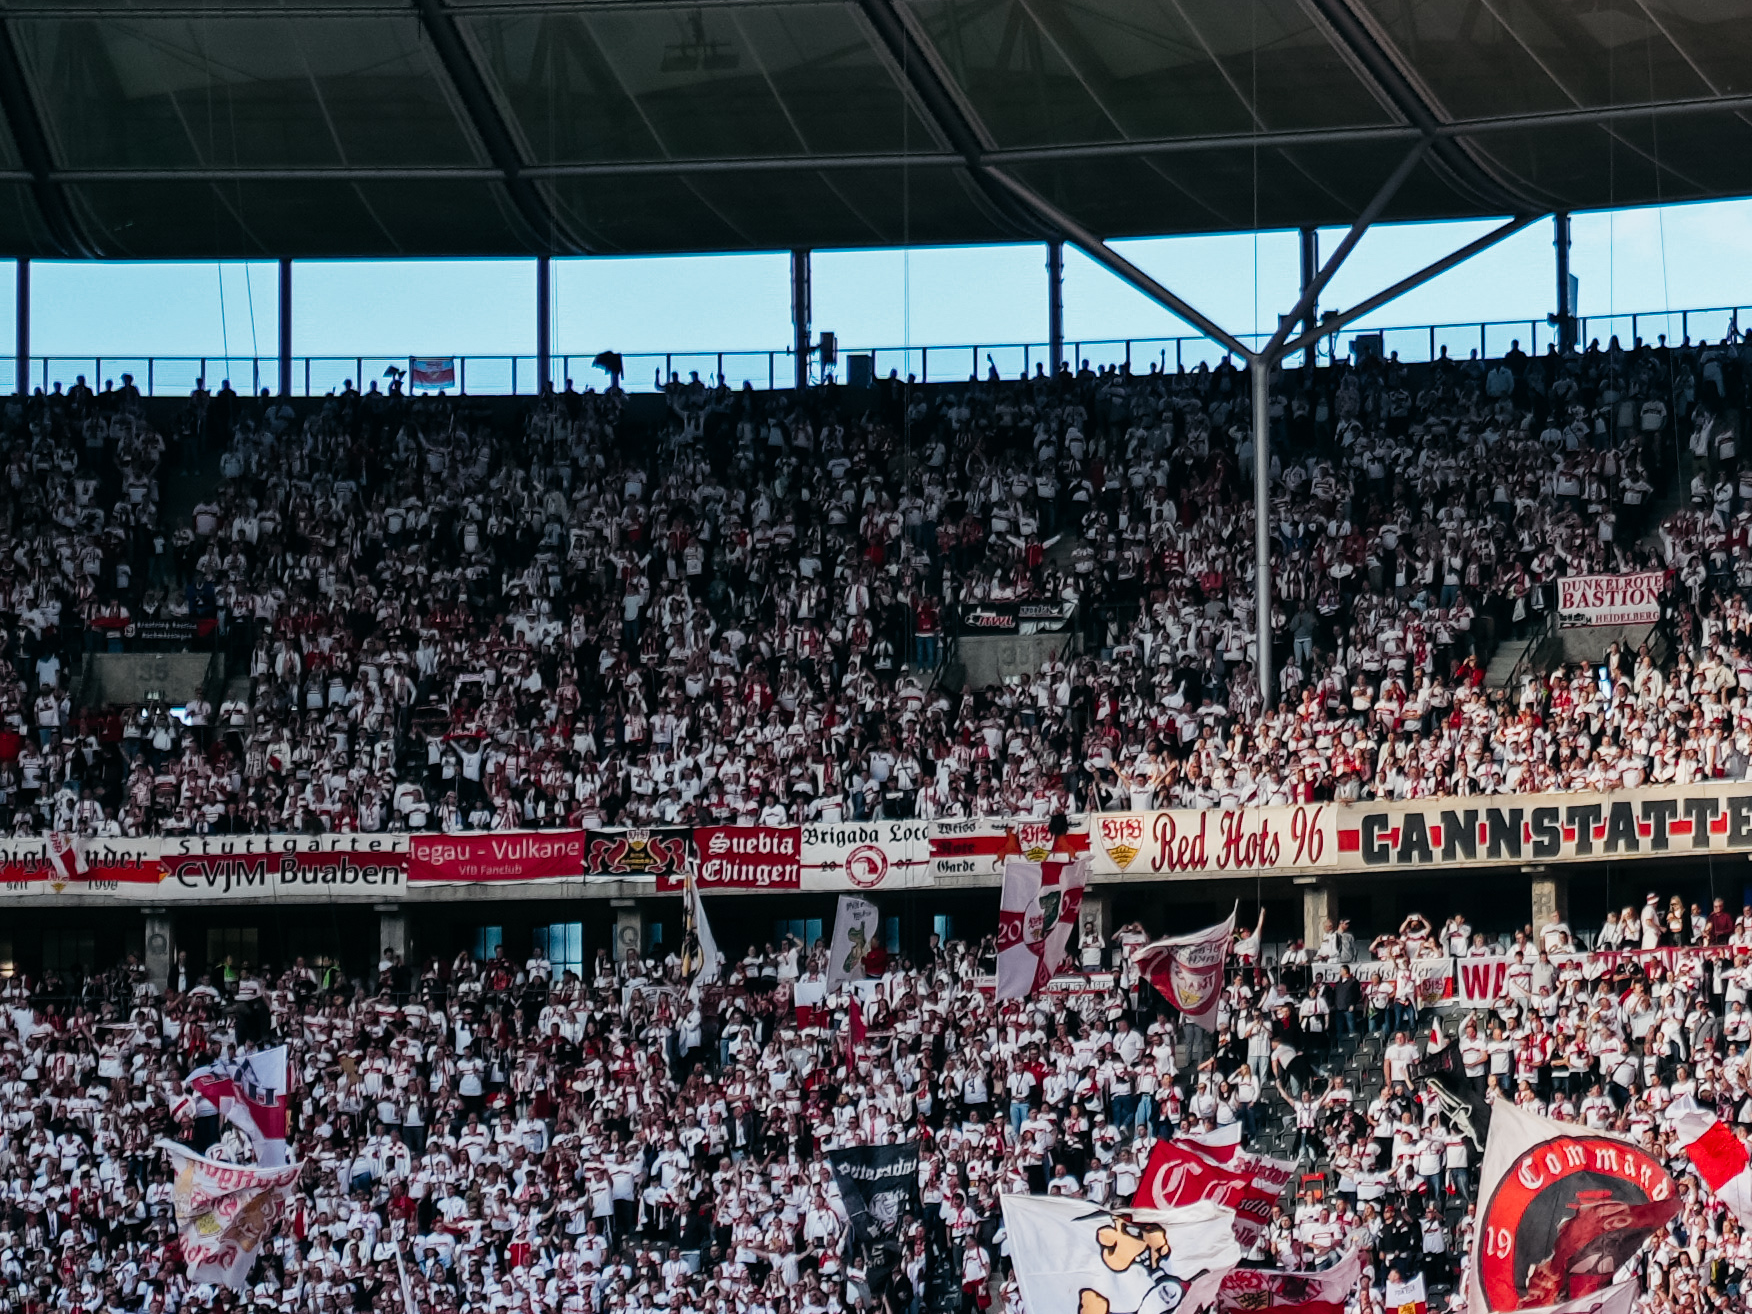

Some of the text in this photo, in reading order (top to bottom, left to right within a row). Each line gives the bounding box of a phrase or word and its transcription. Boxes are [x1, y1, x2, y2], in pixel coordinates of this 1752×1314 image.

[1557, 571, 1666, 596] DUNKELROTE
[1561, 588, 1659, 612] BASTION
[1594, 608, 1660, 626] HEIDELBERG
[708, 833, 794, 856] Suebia
[802, 820, 880, 848] Brigada
[1150, 811, 1209, 874] Red
[1215, 807, 1281, 871] Hots
[1289, 803, 1324, 866] 96
[177, 839, 402, 857] Stuttgarter
[491, 837, 580, 860] Vulkane
[176, 858, 400, 893] CVJM Buaben
[457, 863, 523, 876] VfB Fanclub
[997, 922, 1023, 944] 20
[1517, 1144, 1670, 1202] Command
[1486, 1225, 1513, 1260] 19
